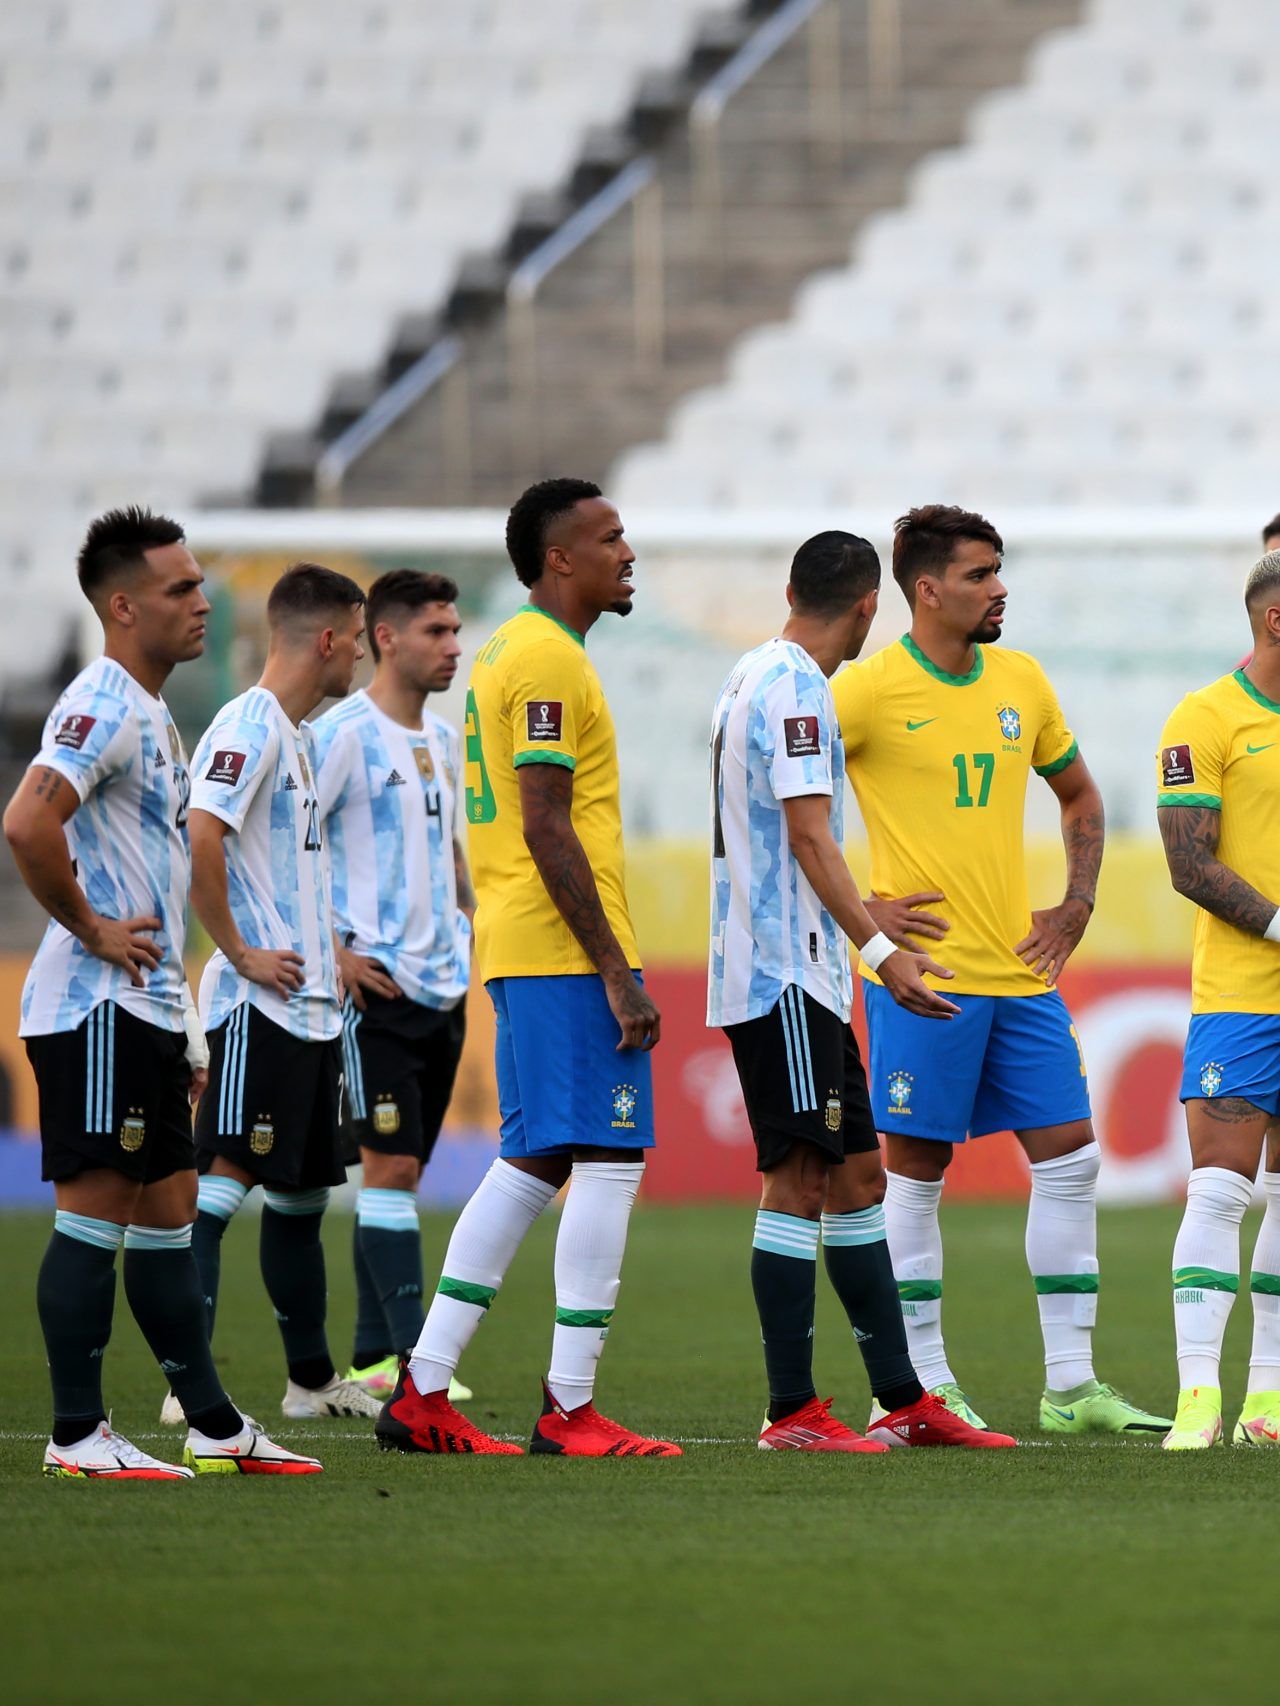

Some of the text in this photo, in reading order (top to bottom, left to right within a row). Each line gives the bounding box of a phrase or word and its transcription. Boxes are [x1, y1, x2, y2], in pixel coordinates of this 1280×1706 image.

[1002, 744, 1022, 754] BRASIL
[952, 753, 995, 808] 17
[425, 791, 443, 841] 4
[888, 1106, 912, 1115] BRASIL
